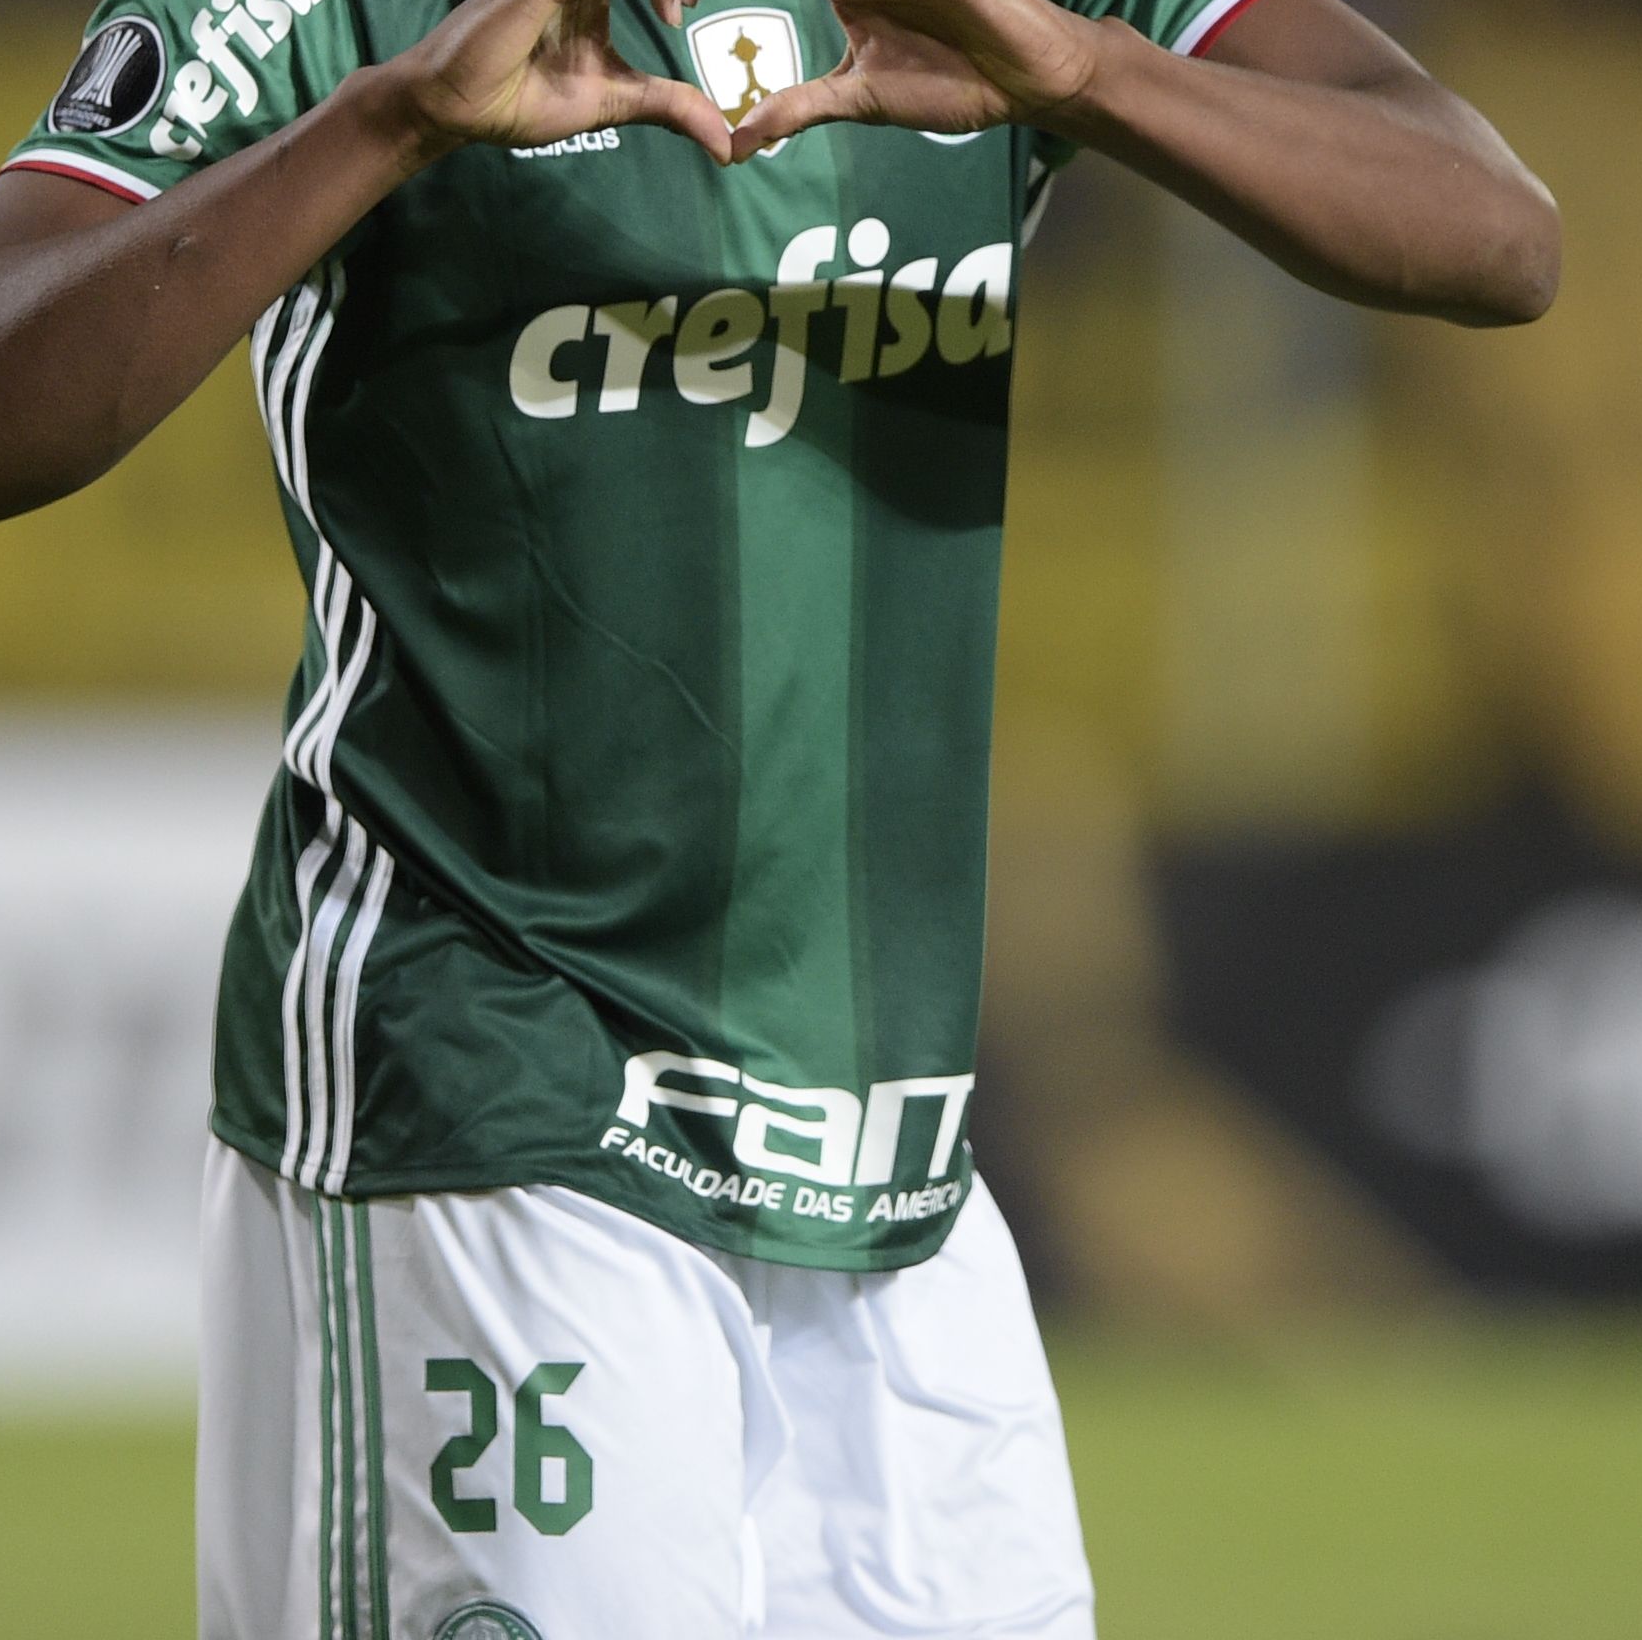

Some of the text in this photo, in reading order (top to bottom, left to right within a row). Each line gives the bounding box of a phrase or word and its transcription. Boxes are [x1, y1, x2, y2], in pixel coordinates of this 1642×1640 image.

[509, 217, 1014, 448] crefisa
[793, 1186, 854, 1223] DAS
[425, 1358, 593, 1536] 26
